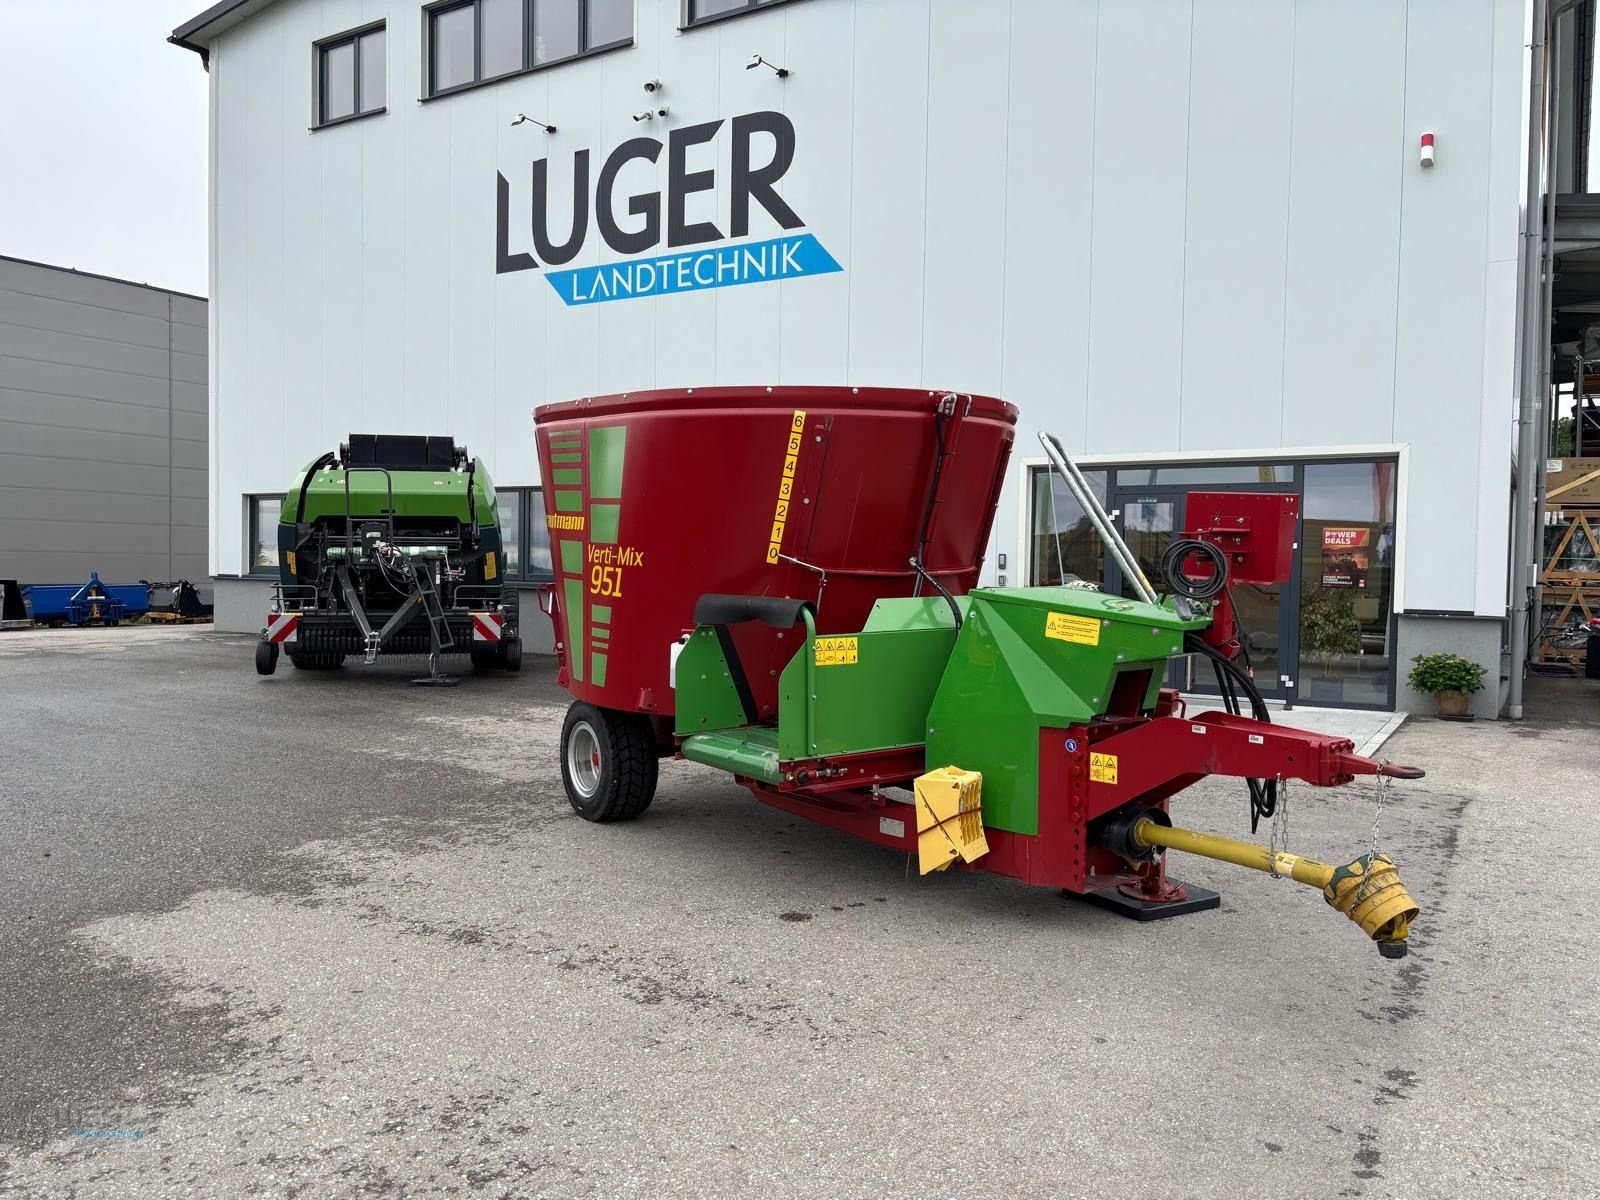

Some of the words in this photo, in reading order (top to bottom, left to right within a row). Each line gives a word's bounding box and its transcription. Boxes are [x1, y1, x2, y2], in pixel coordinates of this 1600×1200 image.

[496, 111, 806, 275] LUGER
[573, 241, 804, 302] LANDTECHNIK
[794, 415, 803, 428] 6
[790, 438, 799, 451] 5
[786, 461, 794, 472] 4
[782, 483, 790, 495] 3
[777, 505, 786, 517] 2
[775, 527, 781, 538] 1
[588, 544, 644, 567] Verti-Mix
[770, 547, 778, 559] 0
[590, 565, 622, 598] 951
